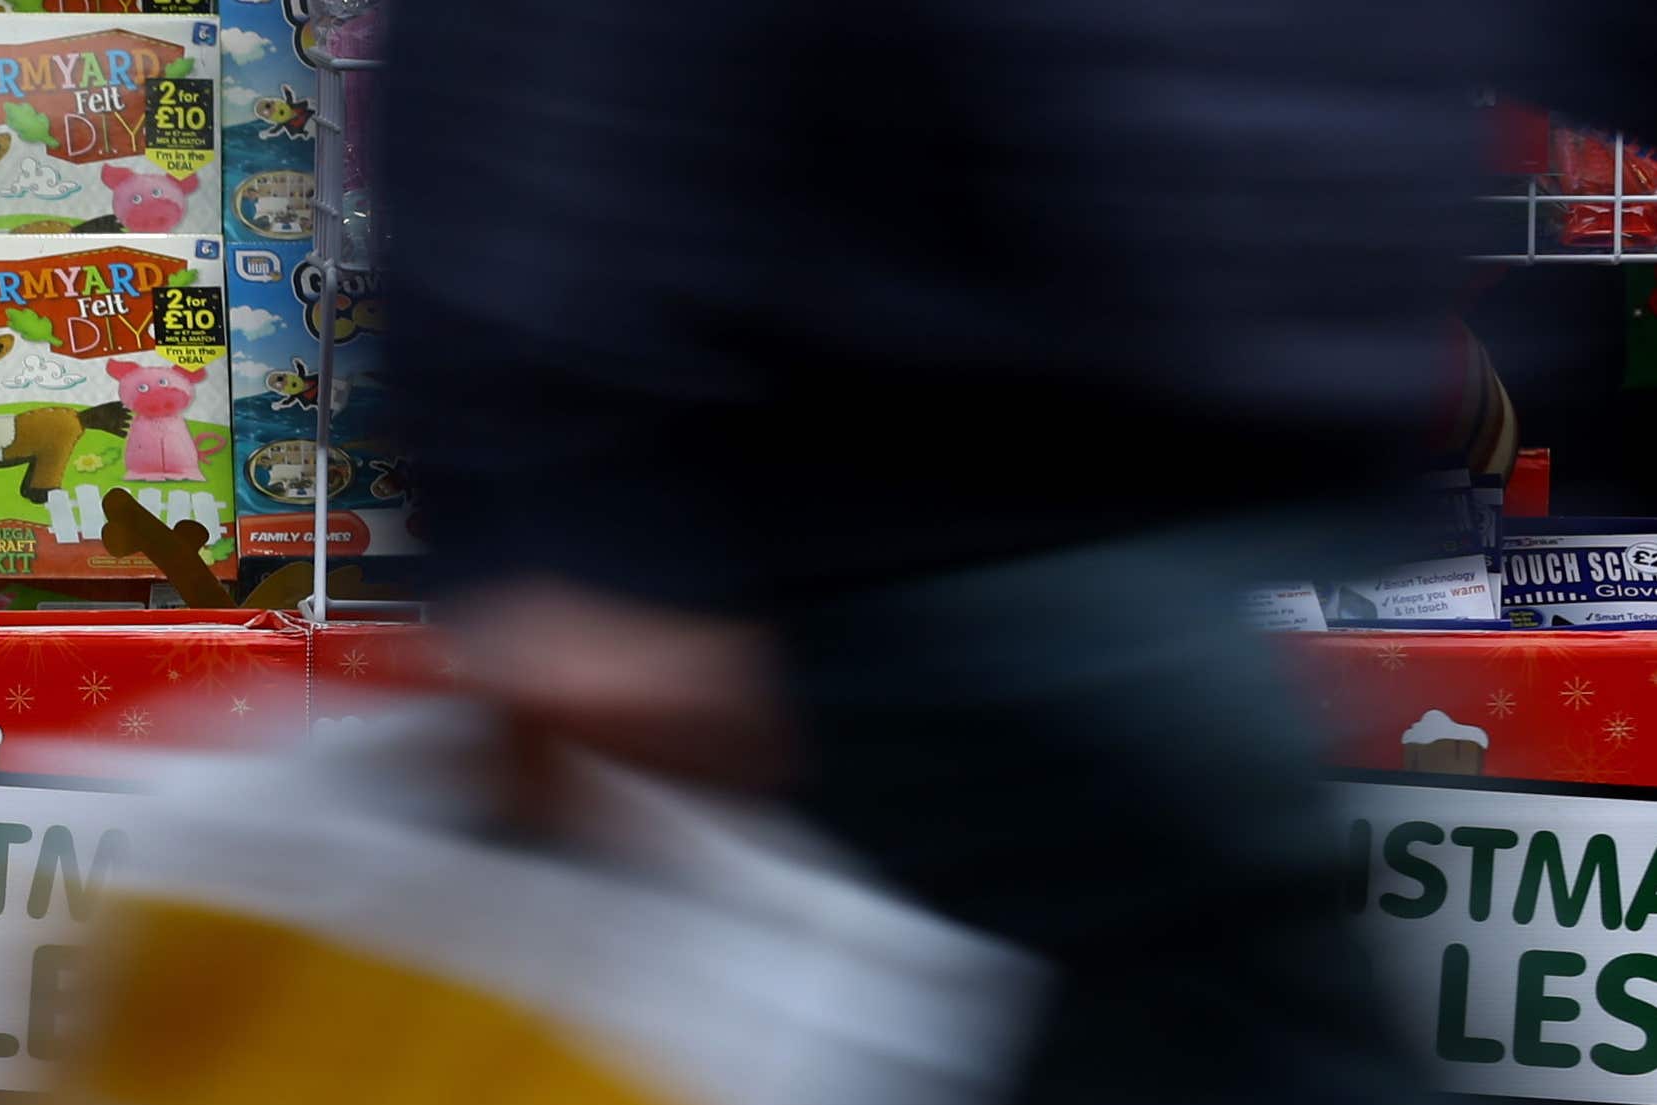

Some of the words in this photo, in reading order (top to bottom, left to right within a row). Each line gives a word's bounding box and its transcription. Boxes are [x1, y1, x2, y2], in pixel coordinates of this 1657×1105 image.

[74, 85, 126, 115] Felt
[159, 81, 176, 105] 2
[178, 90, 199, 103] for
[155, 106, 206, 130] £10
[156, 151, 172, 160] I'm
[175, 151, 186, 160] in
[187, 151, 205, 161] the
[167, 161, 194, 170] DEAL
[77, 293, 129, 319] Felt
[166, 289, 184, 309] 2
[186, 296, 207, 307] for
[163, 309, 215, 330] £10
[178, 356, 204, 364] DEAL
[250, 532, 300, 542] FAMILY
[1501, 552, 1581, 586] TOUCH
[1415, 571, 1477, 588] Technology
[1426, 590, 1447, 603] you
[1450, 583, 1486, 597] warm
[1595, 584, 1657, 598] Glov
[1417, 602, 1449, 614] touch
[1594, 612, 1626, 622] Smart
